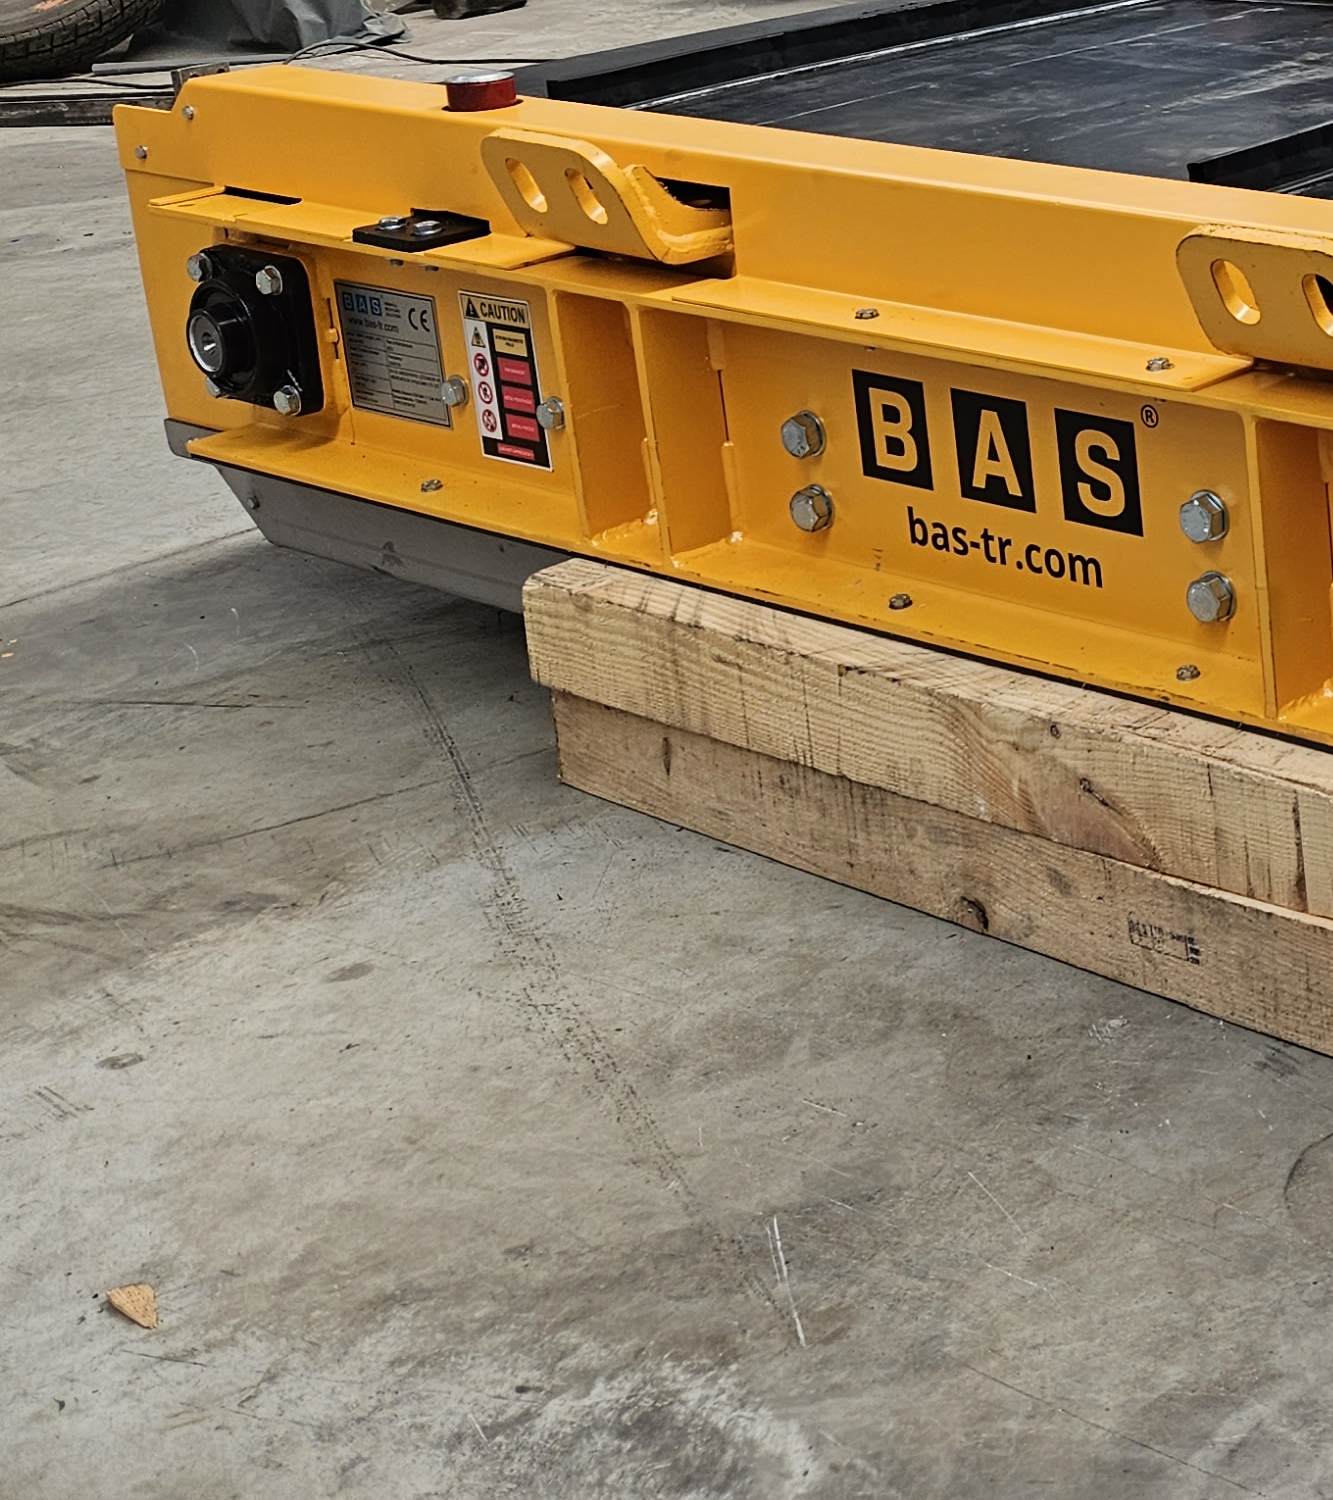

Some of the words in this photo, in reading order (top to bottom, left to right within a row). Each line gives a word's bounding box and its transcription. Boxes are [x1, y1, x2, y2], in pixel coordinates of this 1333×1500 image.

[480, 301, 526, 324] CAUTION
[866, 383, 1128, 519] BAS
[906, 506, 1104, 589] bas-tr.com
